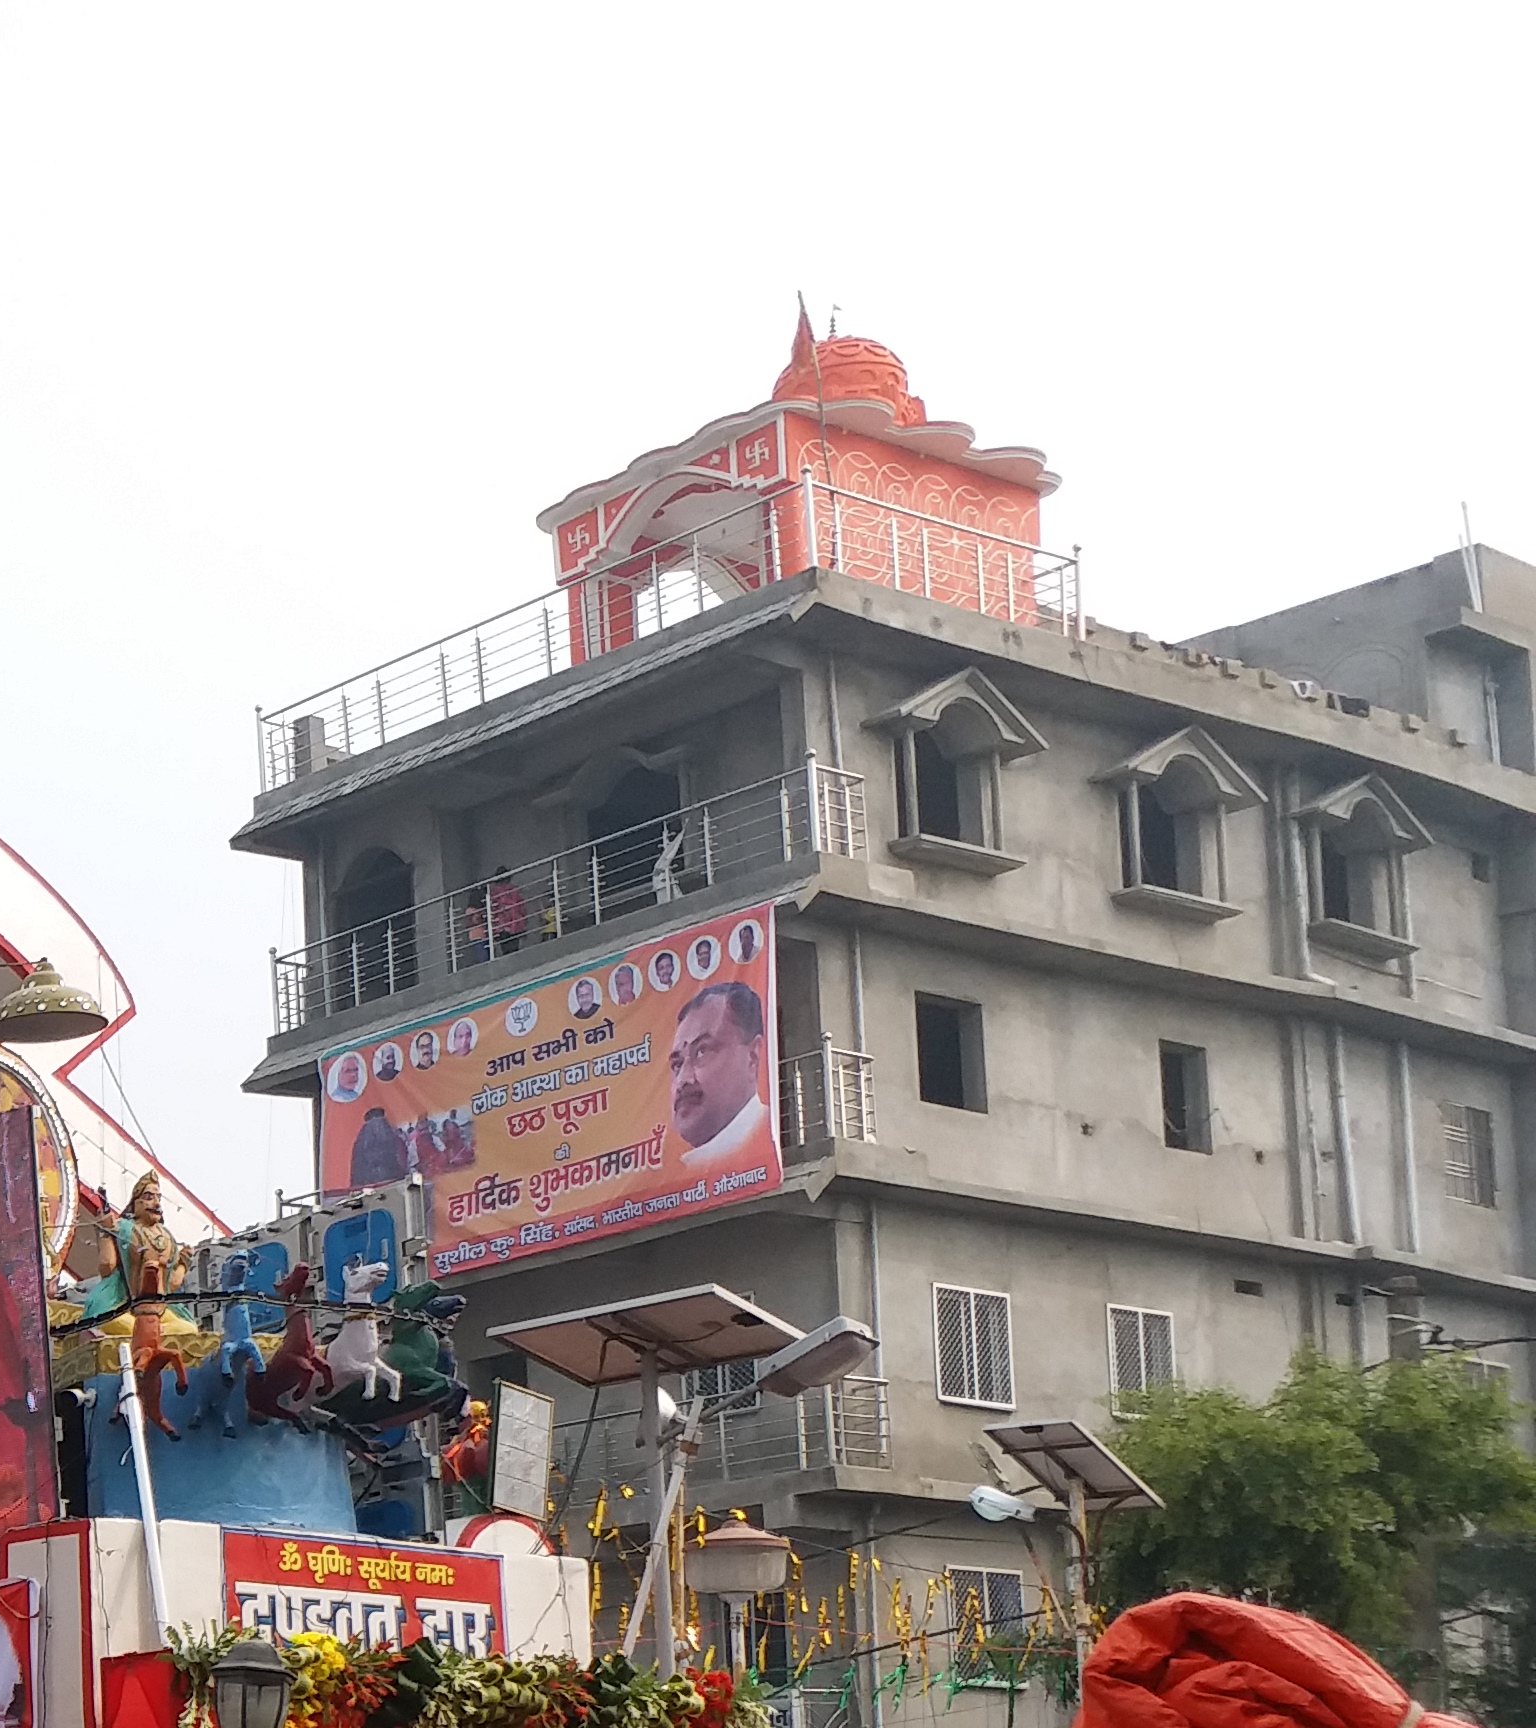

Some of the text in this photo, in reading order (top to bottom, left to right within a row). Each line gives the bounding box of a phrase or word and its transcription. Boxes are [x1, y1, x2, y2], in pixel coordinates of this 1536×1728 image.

[486, 1018, 614, 1076] आप सभी को
[472, 1033, 651, 1115] लोक आस्था का महापर्व
[506, 1088, 609, 1138] छठ पूजा
[554, 1143, 571, 1161] की
[448, 1173, 523, 1225] हार्दिक
[434, 1241, 485, 1273] सुशील
[602, 1201, 642, 1224] भारतीय
[645, 1195, 679, 1213] जनता
[279, 1542, 302, 1571] ॐ
[357, 1552, 412, 1589] सूर्याय
